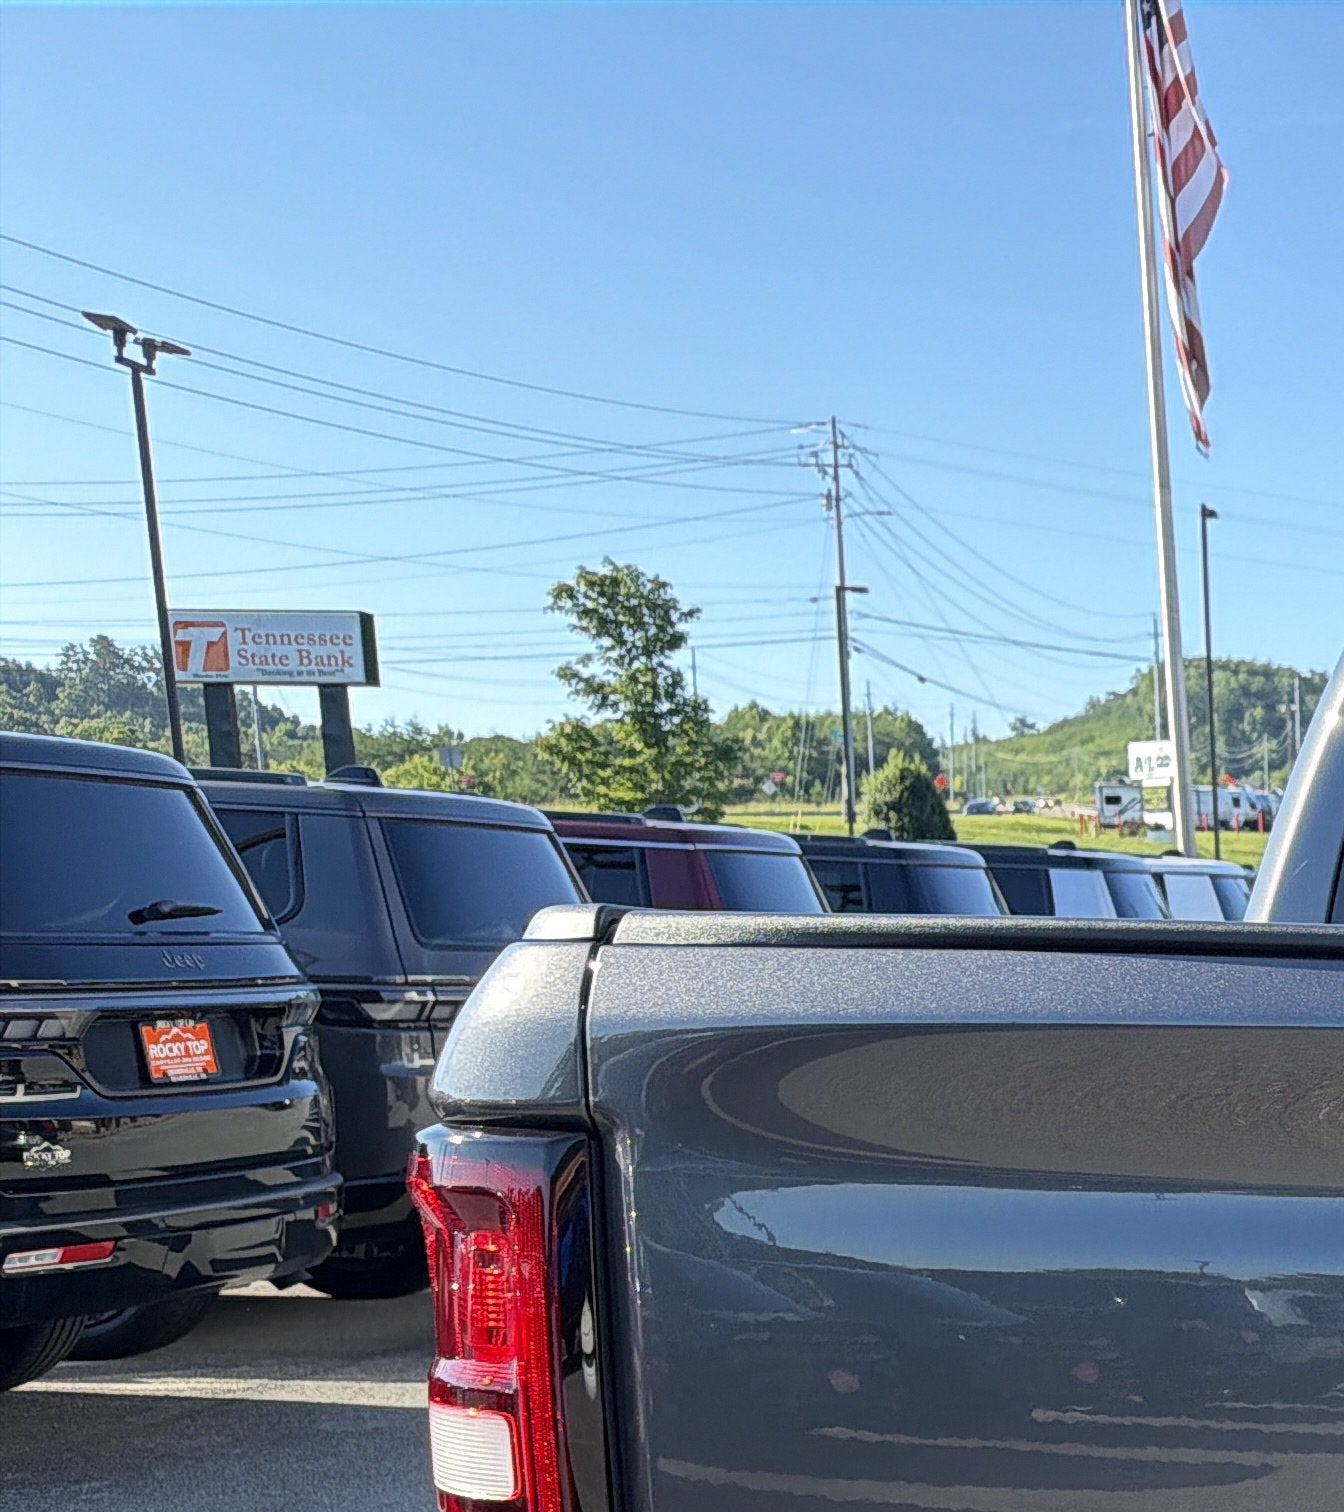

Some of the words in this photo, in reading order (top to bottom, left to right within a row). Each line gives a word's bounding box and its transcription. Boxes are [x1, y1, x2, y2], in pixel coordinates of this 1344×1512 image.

[234, 627, 354, 647] Tennessee
[237, 649, 290, 668] State
[297, 648, 355, 668] Bank
[162, 948, 205, 970] Jeep
[148, 1041, 187, 1059] ROCKY
[186, 1039, 209, 1056] TOP
